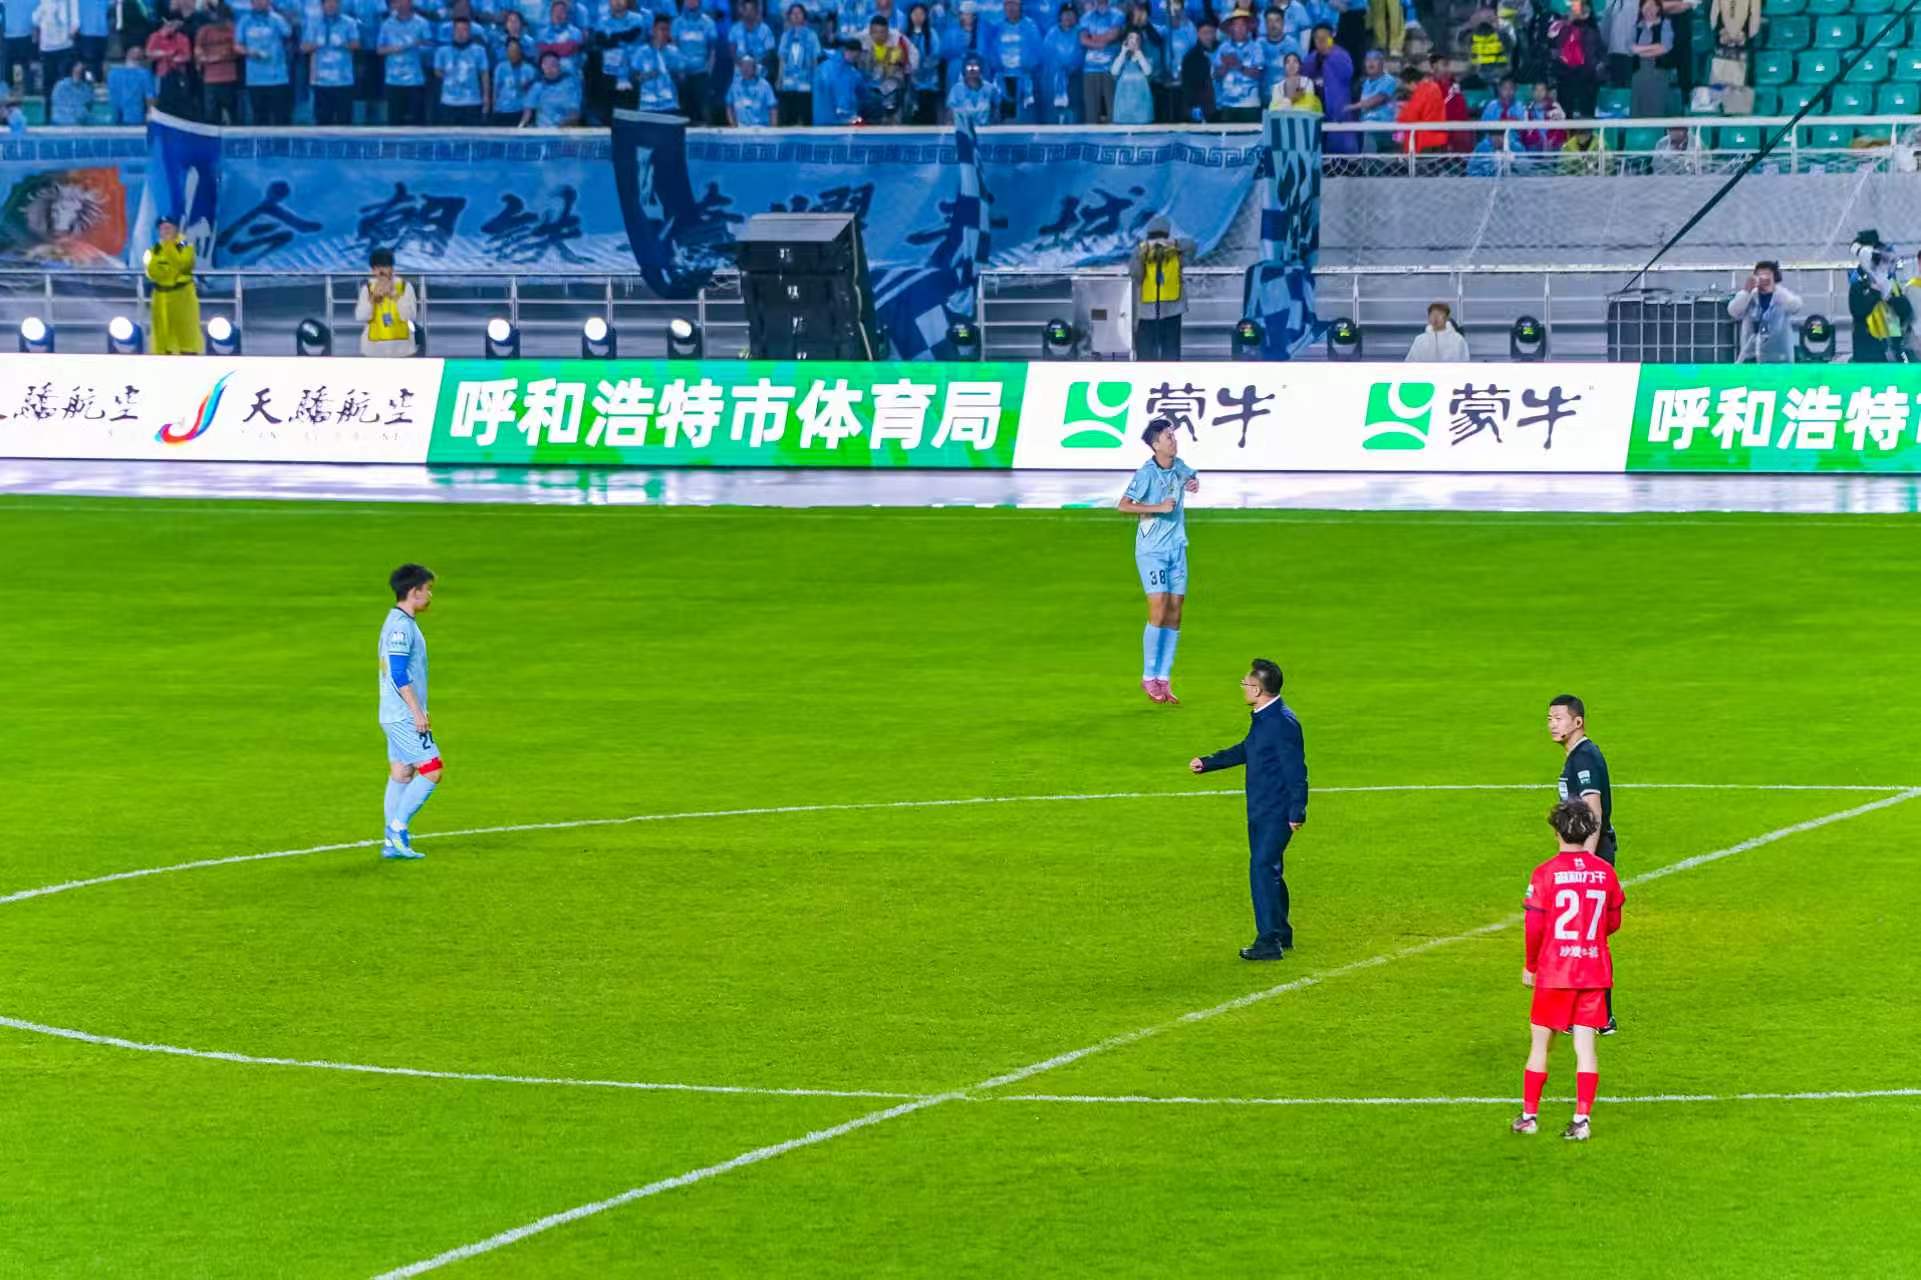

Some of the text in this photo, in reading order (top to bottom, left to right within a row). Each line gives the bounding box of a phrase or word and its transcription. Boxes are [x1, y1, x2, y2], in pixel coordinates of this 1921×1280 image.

[450, 377, 1003, 450] 呼和浩特市体育局
[1146, 382, 1276, 449] 蒙牛
[1450, 382, 1582, 450] 蒙牛
[1647, 385, 1921, 451] 呼和浩特
[1150, 569, 1166, 585] 38
[1555, 889, 1606, 940] 27
